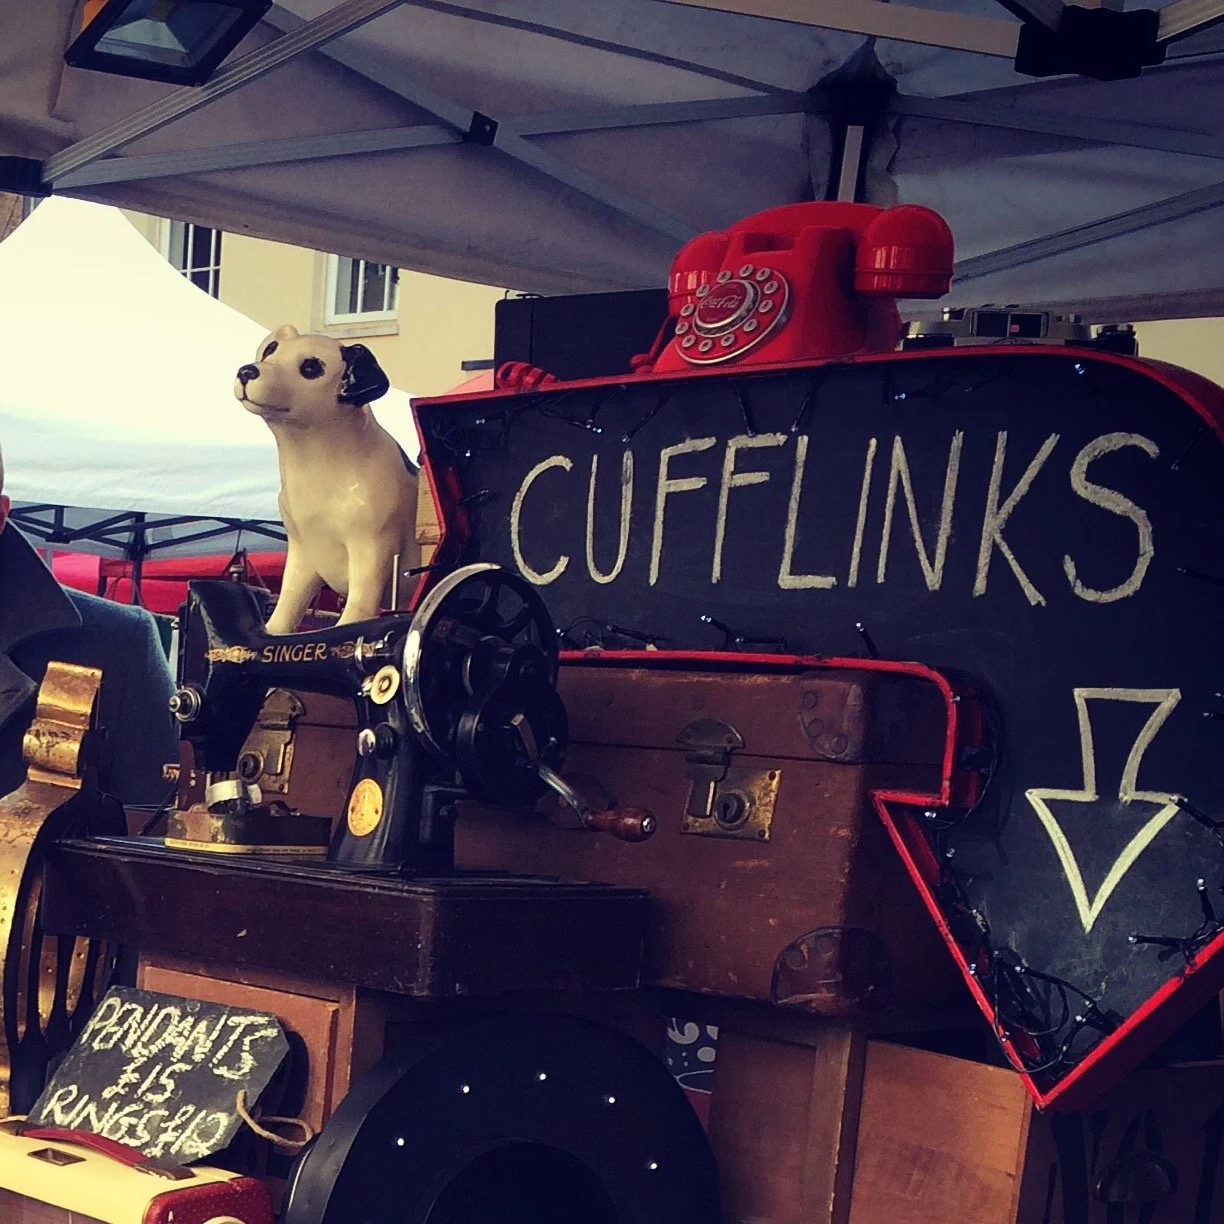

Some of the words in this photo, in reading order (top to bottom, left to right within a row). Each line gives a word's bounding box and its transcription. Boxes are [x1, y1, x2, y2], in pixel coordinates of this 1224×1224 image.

[510, 428, 1160, 606] CUFFLINKS
[261, 642, 328, 664] SINGER
[80, 996, 279, 1080] PENDANTS
[101, 1056, 193, 1102] £15
